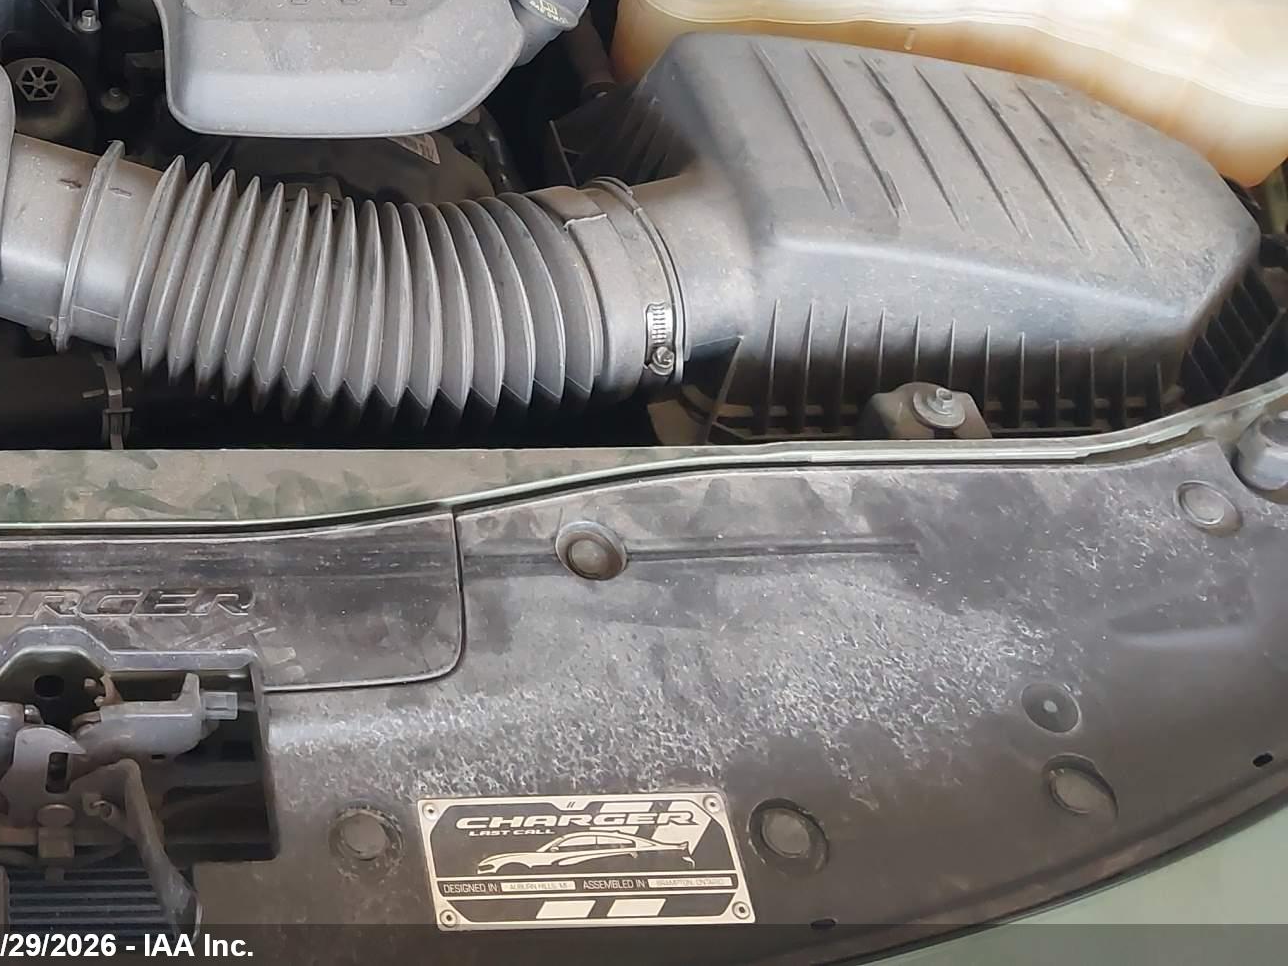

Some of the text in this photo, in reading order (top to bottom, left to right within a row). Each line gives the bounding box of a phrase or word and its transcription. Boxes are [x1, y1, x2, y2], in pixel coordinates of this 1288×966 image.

[455, 811, 699, 829] CHARGER
[443, 883, 486, 894] DESIGNED
[583, 879, 634, 890] ASSEMBLED
